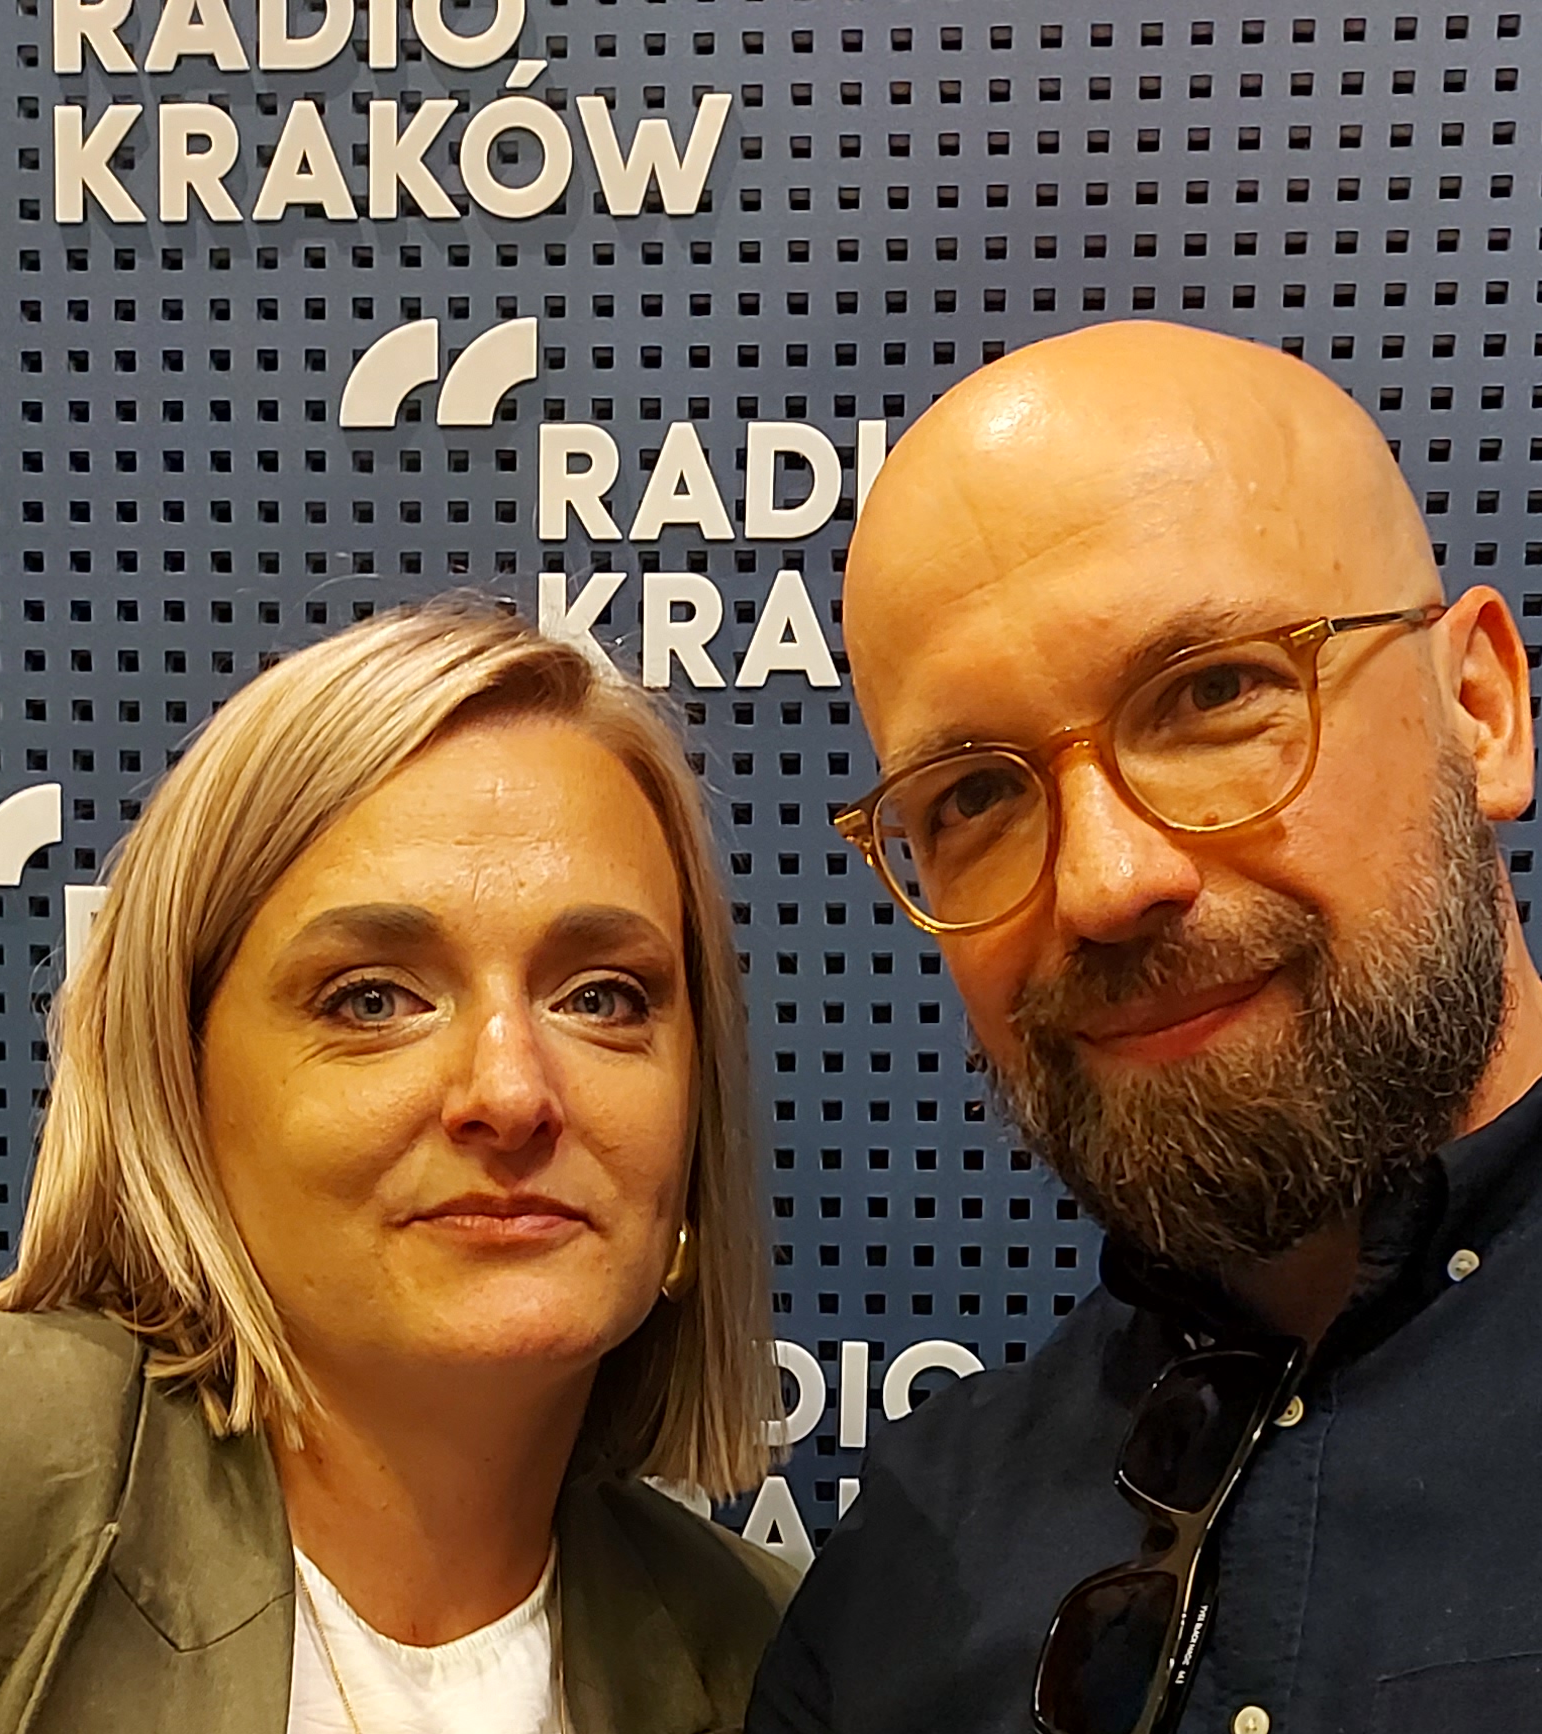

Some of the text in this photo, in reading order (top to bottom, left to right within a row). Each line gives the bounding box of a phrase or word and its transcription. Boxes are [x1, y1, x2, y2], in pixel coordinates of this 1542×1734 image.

[54, 0, 526, 73] RADIO
[55, 59, 732, 223] KRAKÓW
[538, 570, 841, 688] KRA
